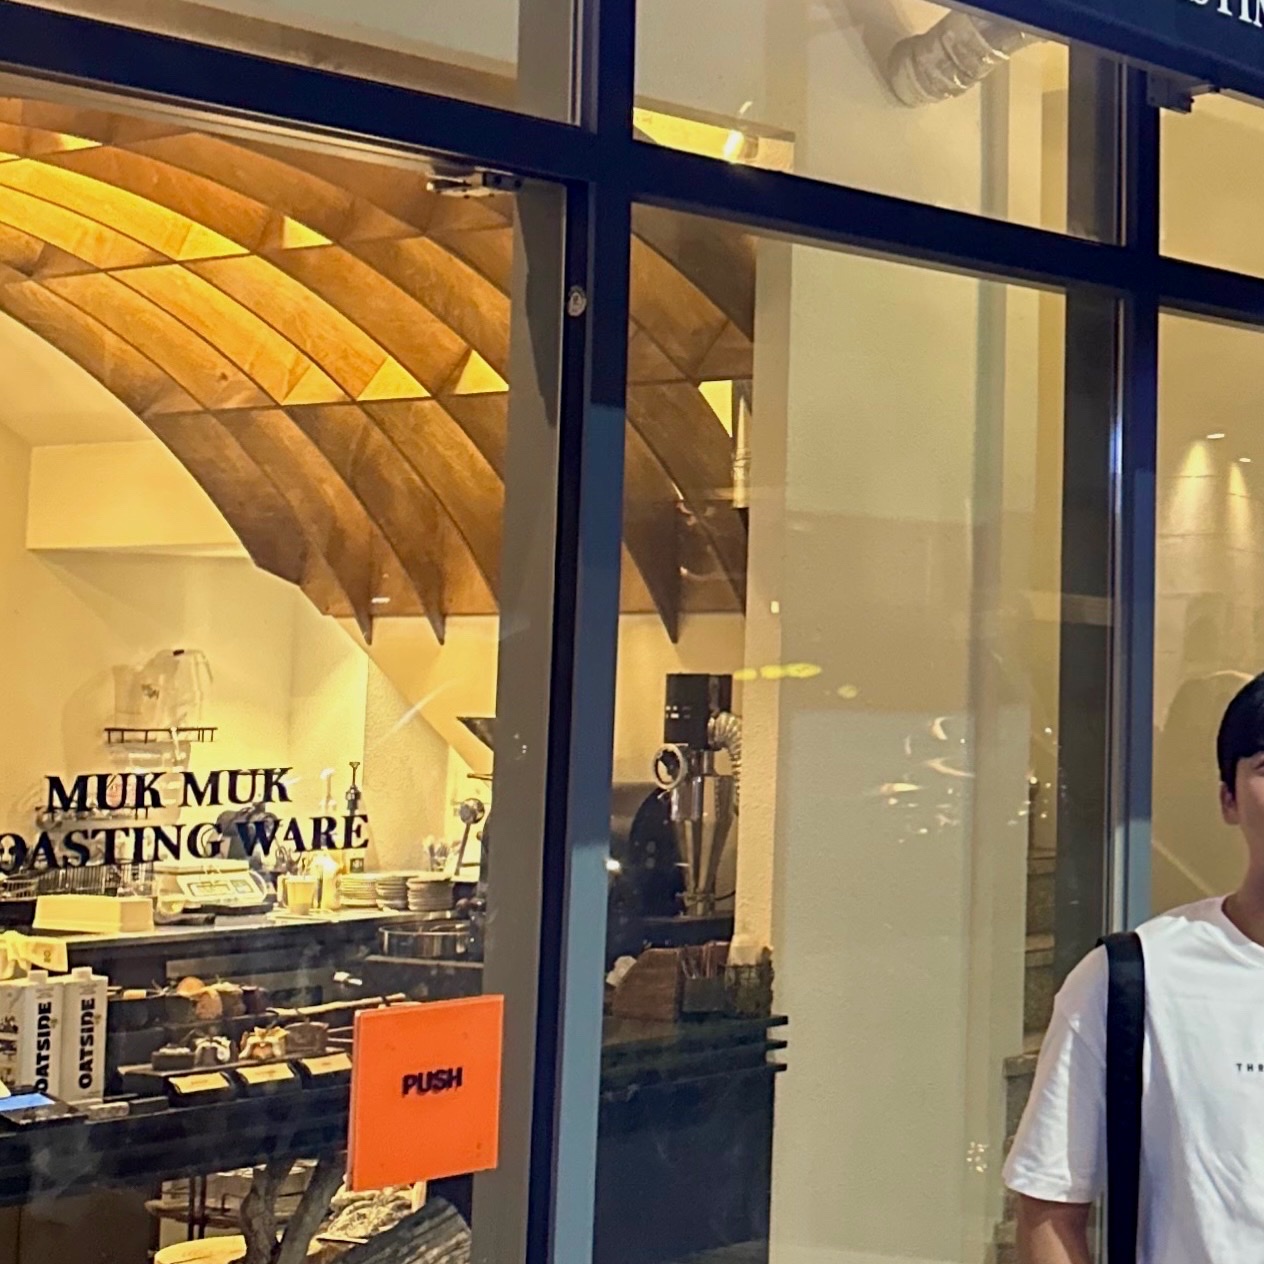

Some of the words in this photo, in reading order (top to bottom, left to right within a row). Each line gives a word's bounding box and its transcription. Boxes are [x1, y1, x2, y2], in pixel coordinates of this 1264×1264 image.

[45, 771, 166, 814] MUK
[180, 767, 294, 808] MUK
[235, 814, 370, 857] WARE
[36, 1001, 52, 1092] OATSIDE
[79, 998, 96, 1089] OATSIDE
[402, 1066, 464, 1096] PUSH
